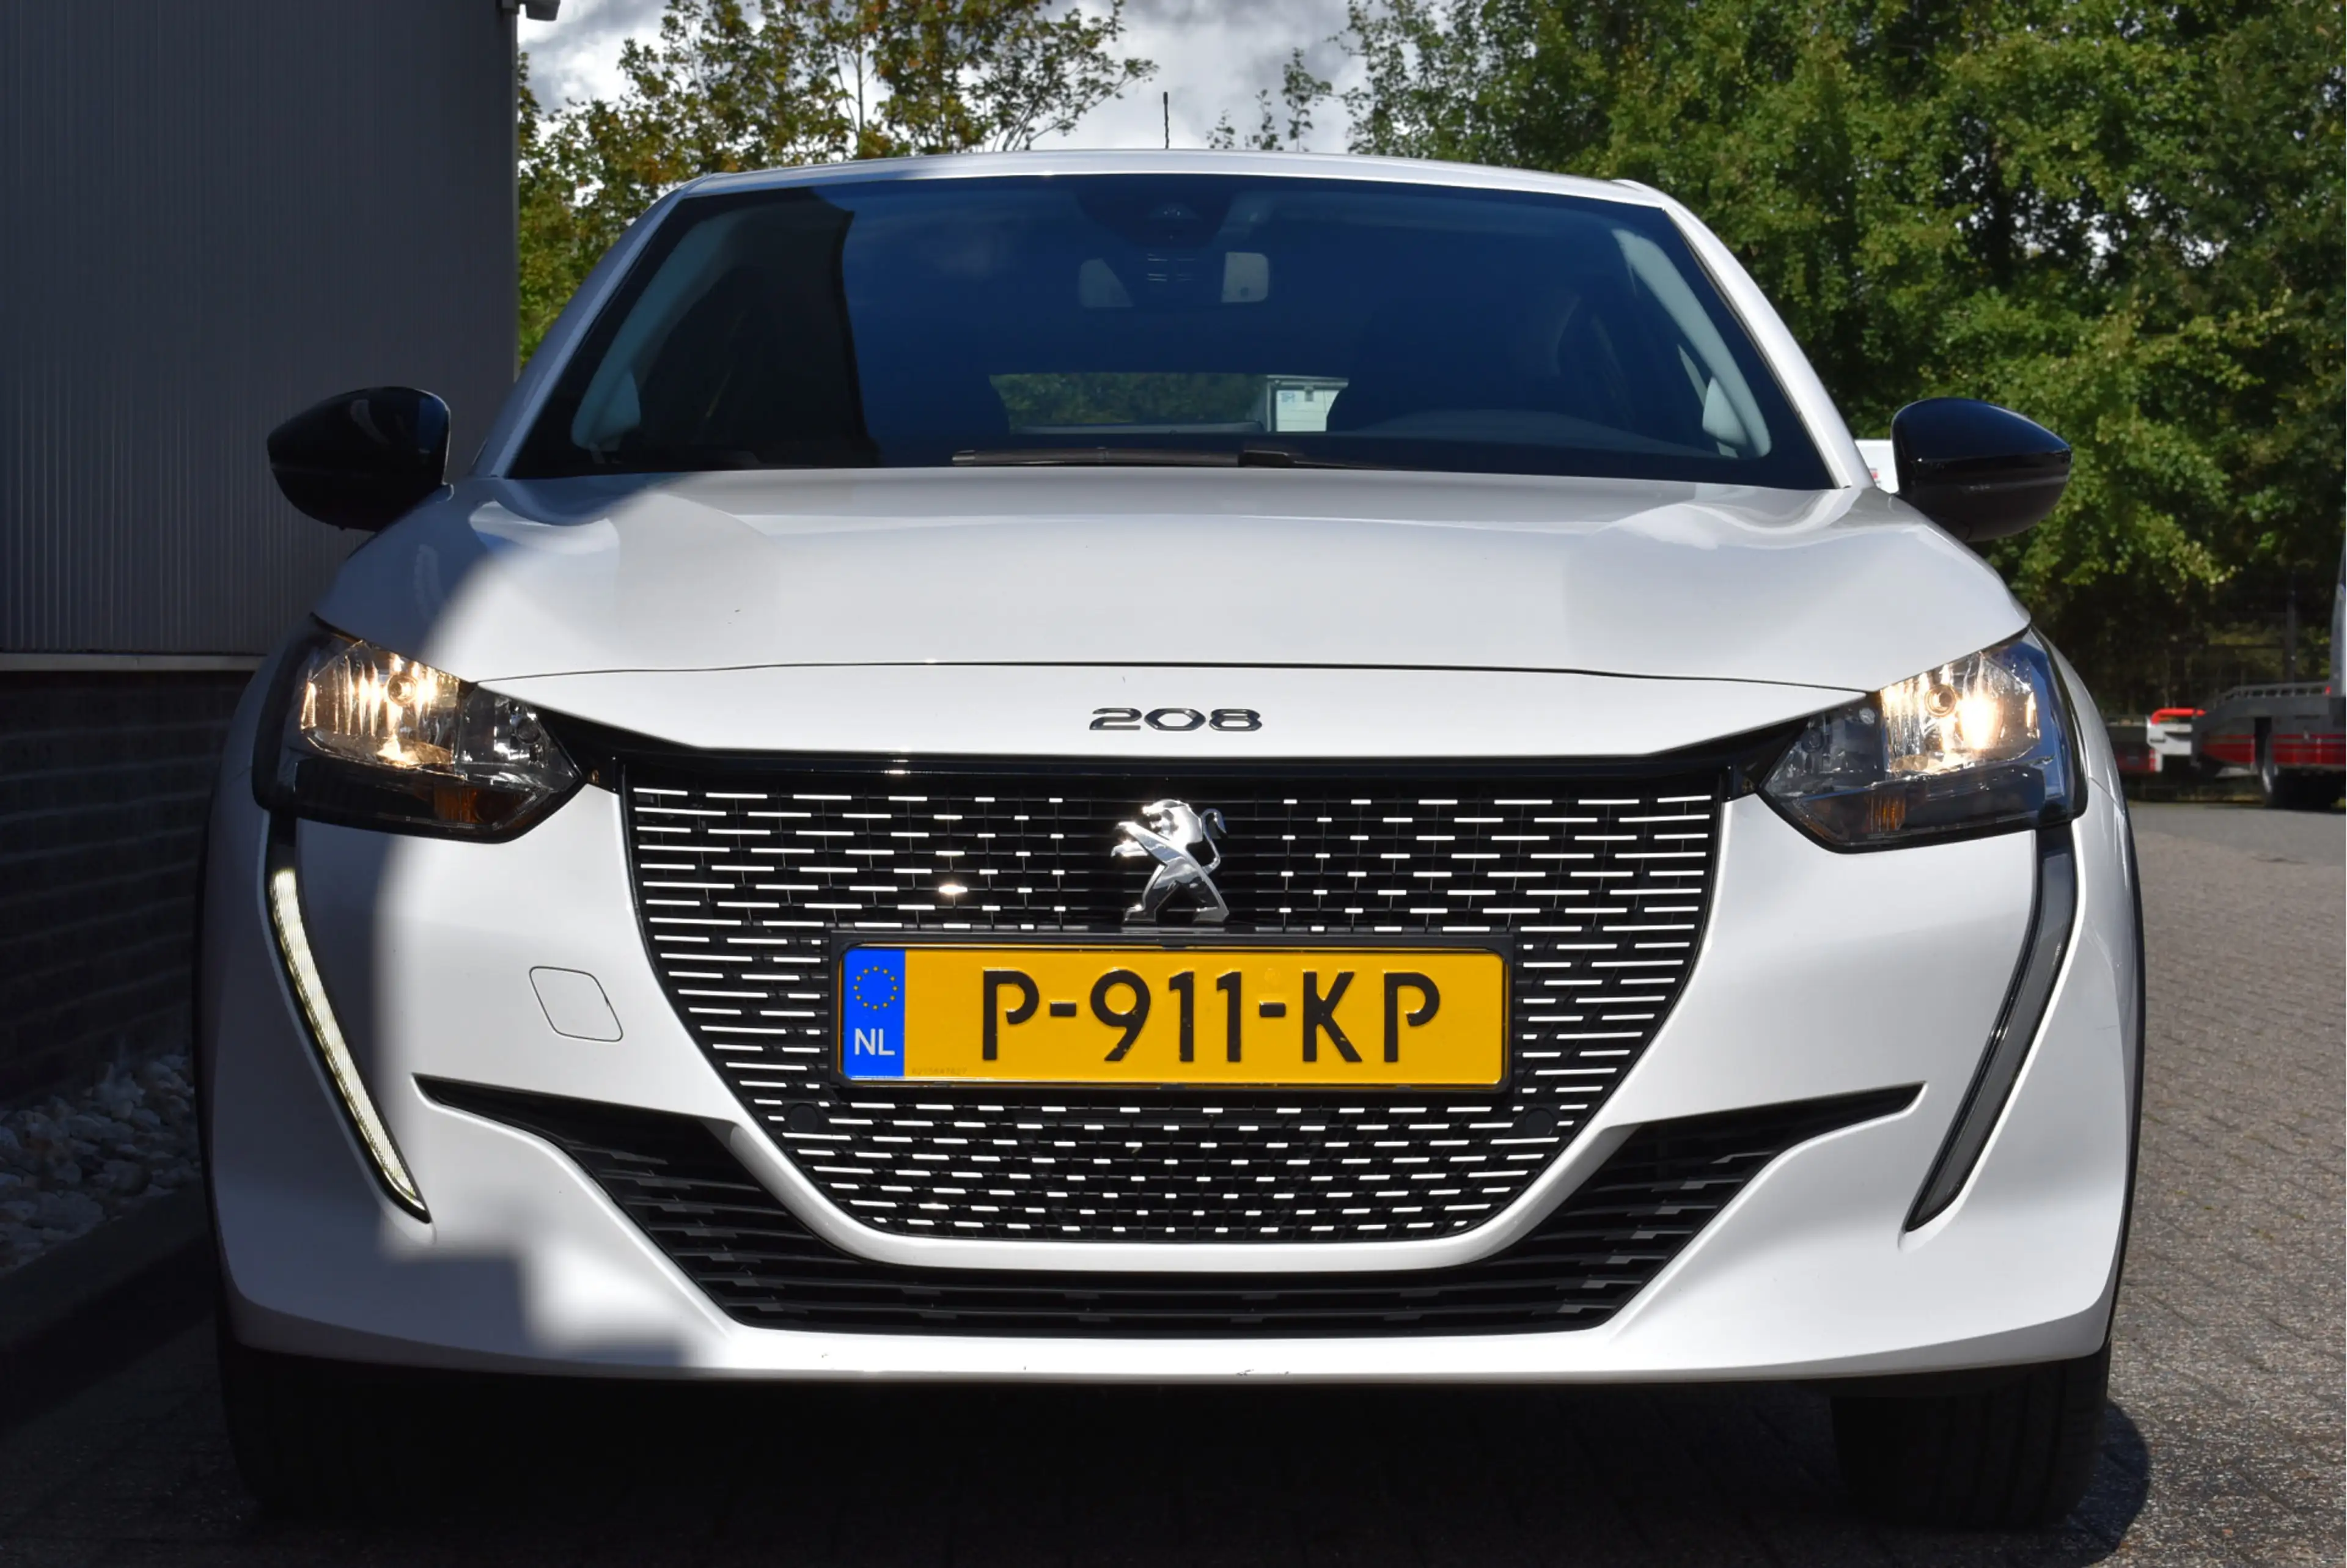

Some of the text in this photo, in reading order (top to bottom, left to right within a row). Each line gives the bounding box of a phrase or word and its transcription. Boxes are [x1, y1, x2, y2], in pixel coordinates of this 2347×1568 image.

[1089, 708, 1263, 732] 208
[982, 969, 1440, 1063] P-911-KP
[855, 1028, 895, 1055] NL
